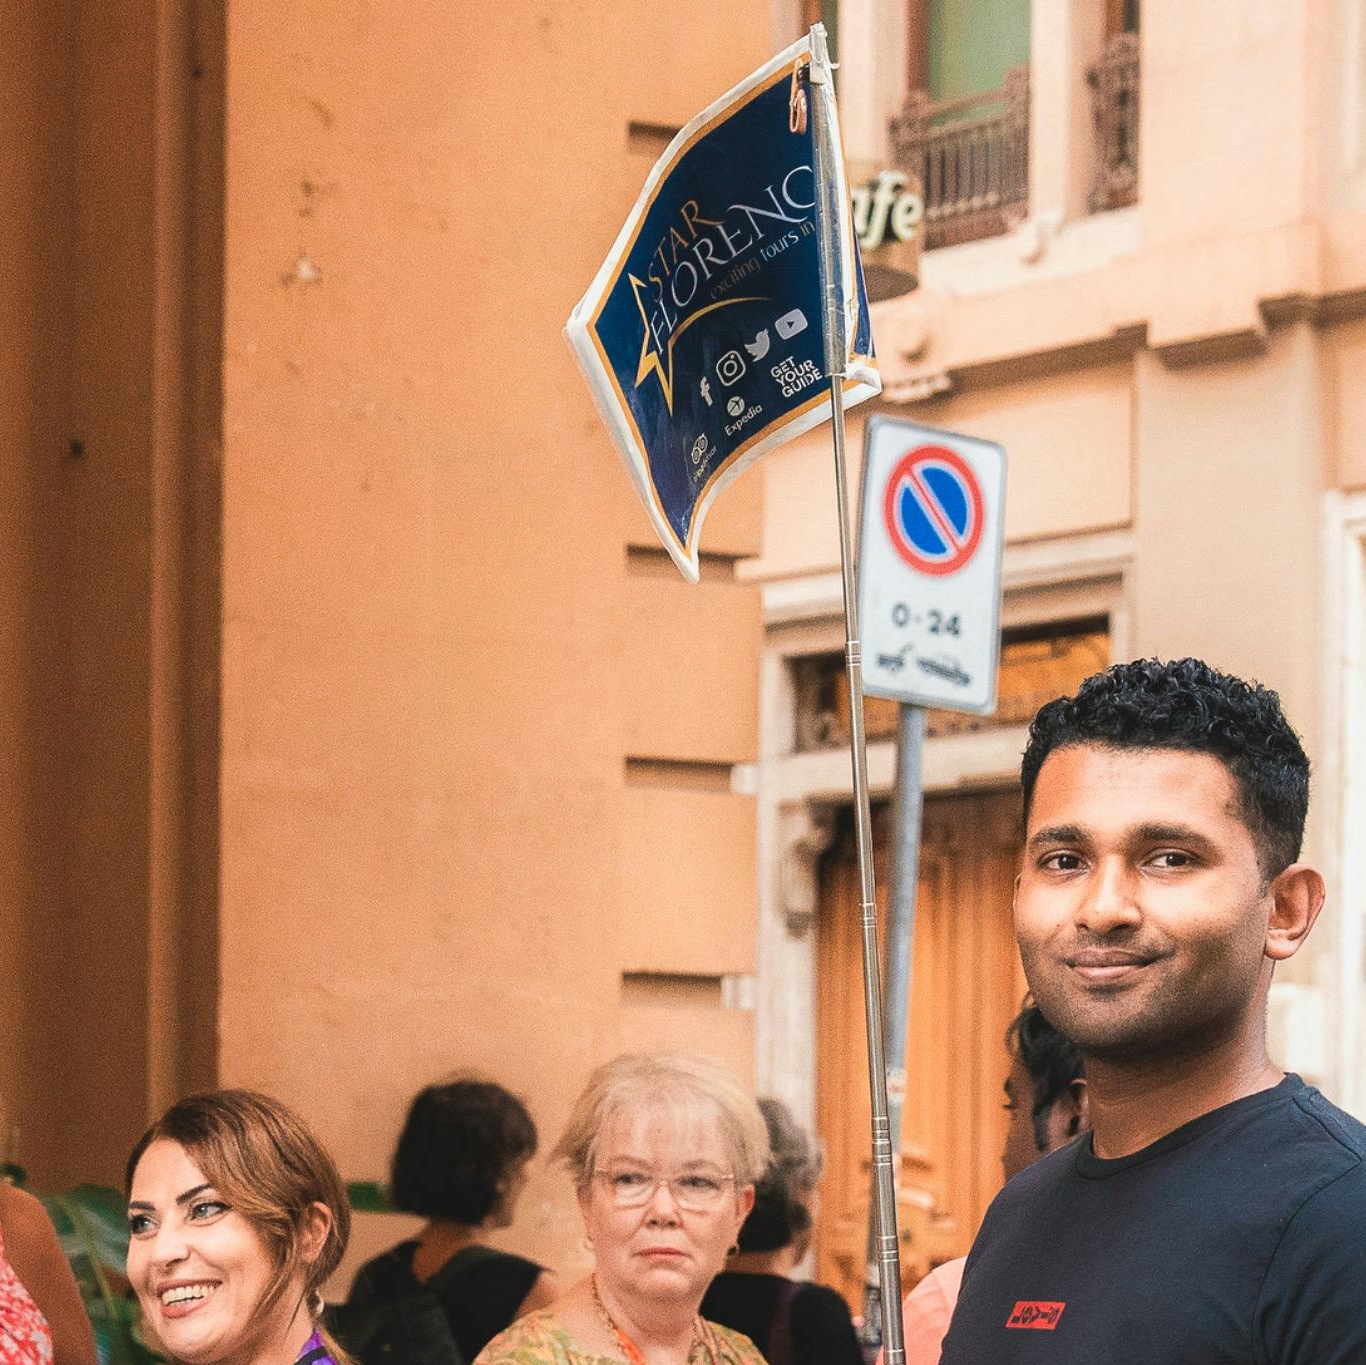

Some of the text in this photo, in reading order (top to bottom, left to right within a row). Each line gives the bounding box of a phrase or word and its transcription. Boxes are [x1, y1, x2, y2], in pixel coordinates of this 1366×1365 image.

[647, 200, 725, 303] STAR
[650, 165, 816, 356] FLORENC
[710, 221, 815, 300] exciting tours in
[771, 356, 795, 378] GET
[776, 359, 815, 387] YOUR
[782, 368, 823, 398] GUIDE
[724, 404, 763, 436] Expedia
